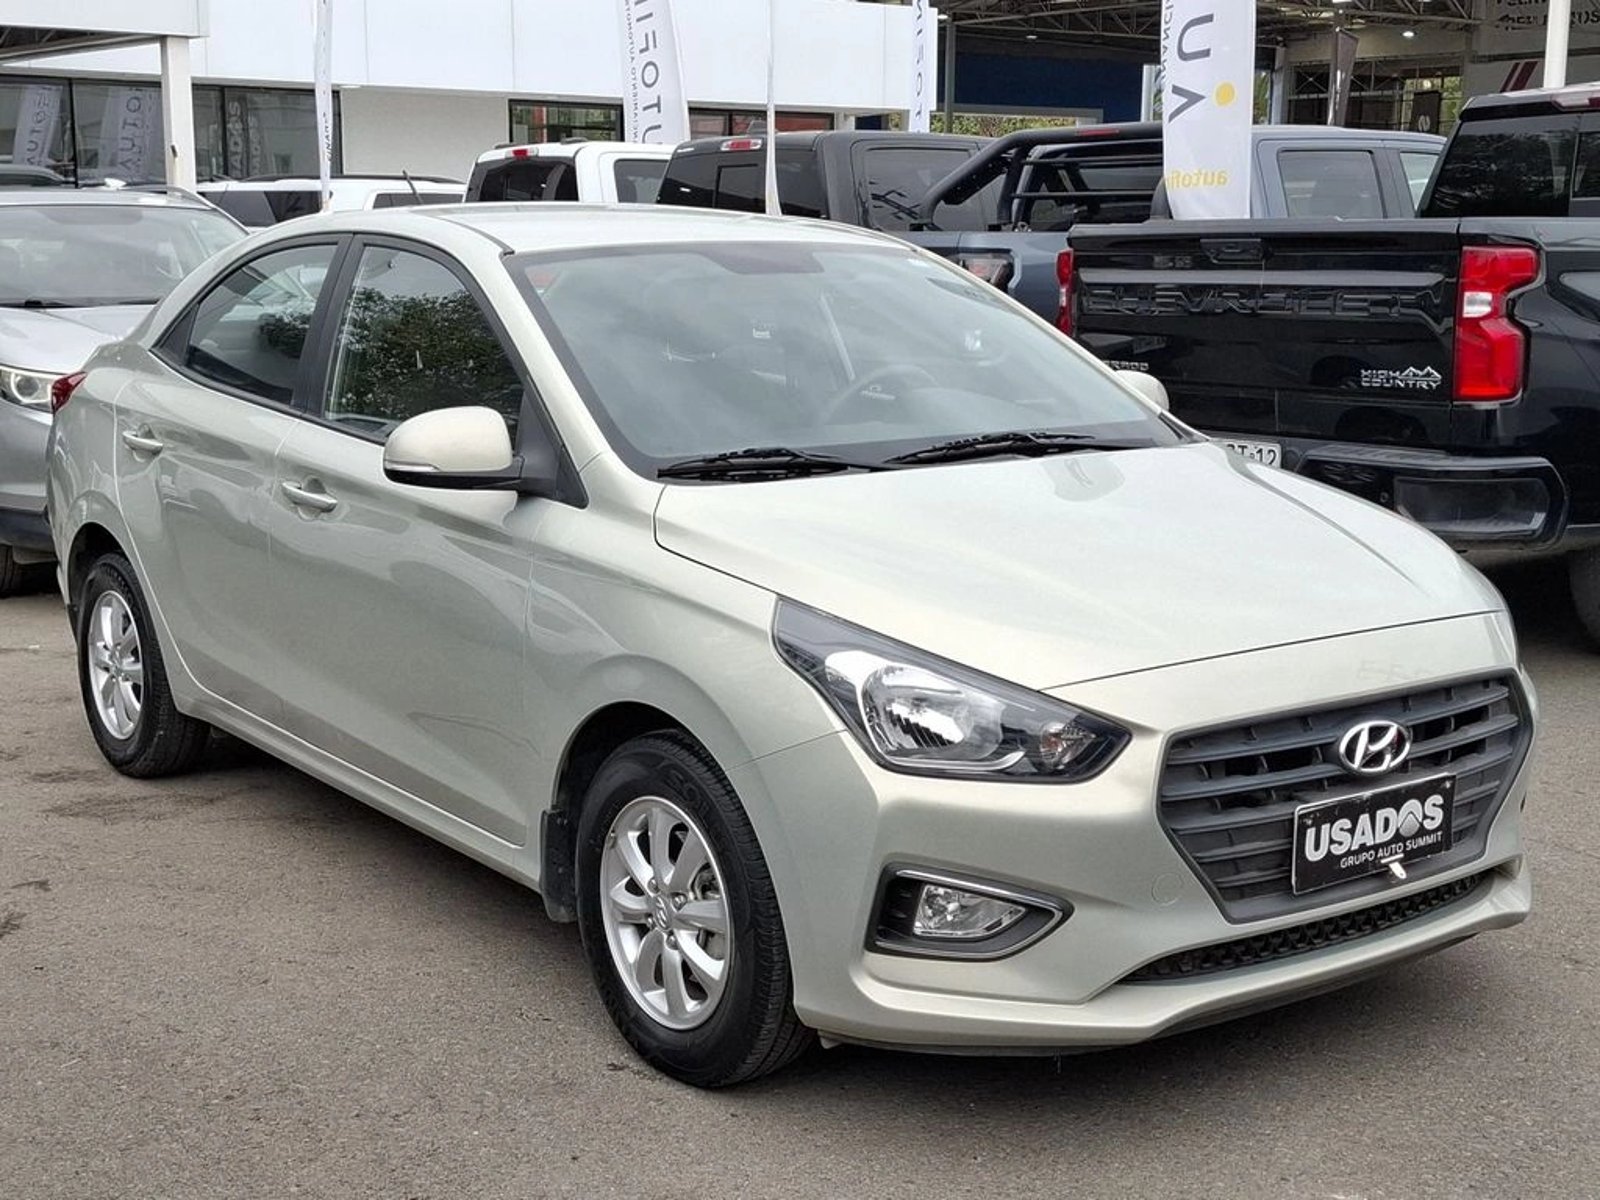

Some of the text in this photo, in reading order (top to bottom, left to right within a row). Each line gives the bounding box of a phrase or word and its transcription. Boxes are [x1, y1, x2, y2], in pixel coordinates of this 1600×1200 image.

[1361, 378, 1441, 390] COUNTRY
[1304, 794, 1445, 862] USADOS
[1340, 831, 1443, 868] GRUPO AUTO SUMMIT
